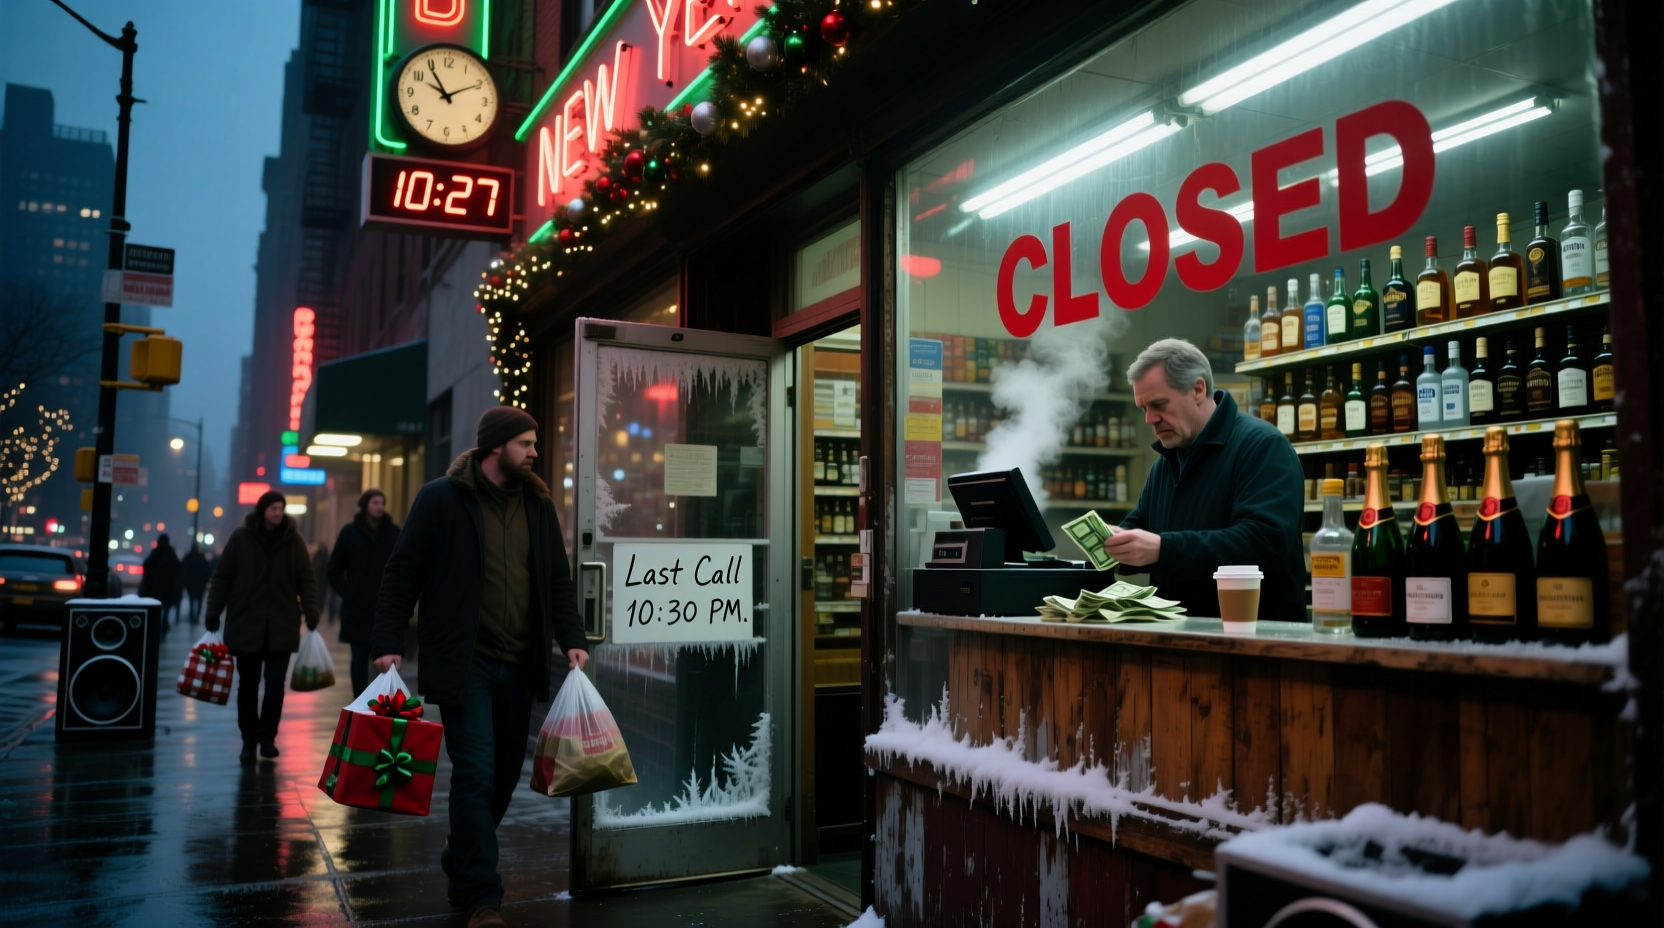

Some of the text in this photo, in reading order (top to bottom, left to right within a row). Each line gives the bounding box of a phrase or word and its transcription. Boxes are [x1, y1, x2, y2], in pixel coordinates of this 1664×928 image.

[443, 57, 455, 69] 12
[407, 87, 414, 98] 9
[481, 97, 488, 107] 3
[411, 105, 419, 116] 8
[474, 113, 482, 123] 4
[538, 40, 625, 206] NEW
[426, 119, 434, 131] 7
[393, 171, 500, 217] 10:27
[996, 100, 1436, 337] CLOSED
[625, 554, 743, 587] Last Call
[627, 598, 748, 628] 10:30 PM.
